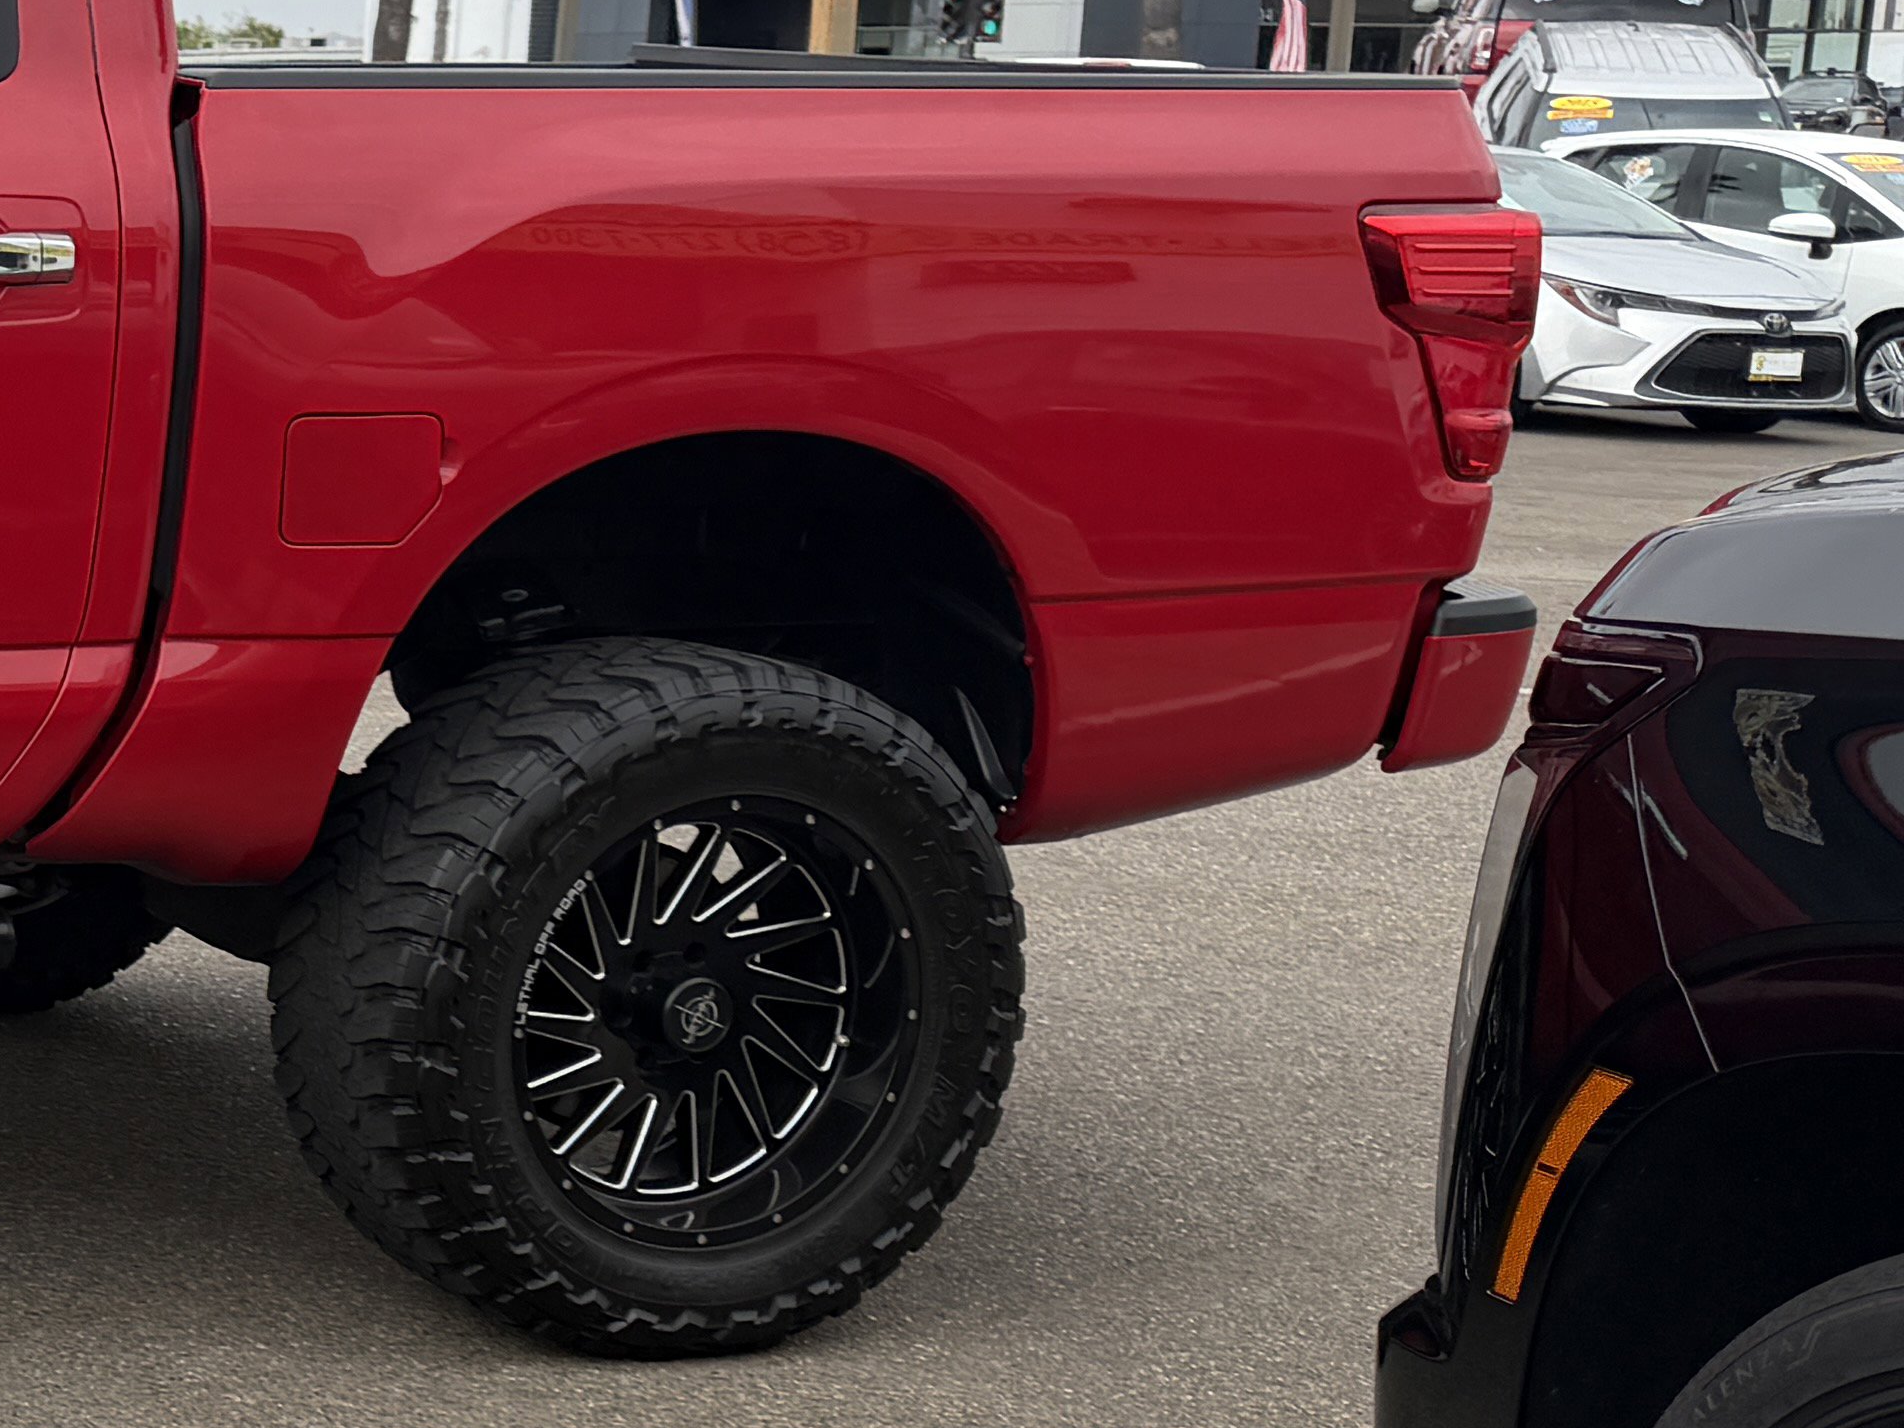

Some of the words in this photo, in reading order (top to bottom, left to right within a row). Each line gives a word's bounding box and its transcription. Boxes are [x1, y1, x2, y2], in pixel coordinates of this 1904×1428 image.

[515, 957, 541, 1025] LETHAL
[534, 921, 555, 955] OFF
[553, 878, 588, 921] ROAD
[1692, 1337, 1795, 1422] ALENZA
